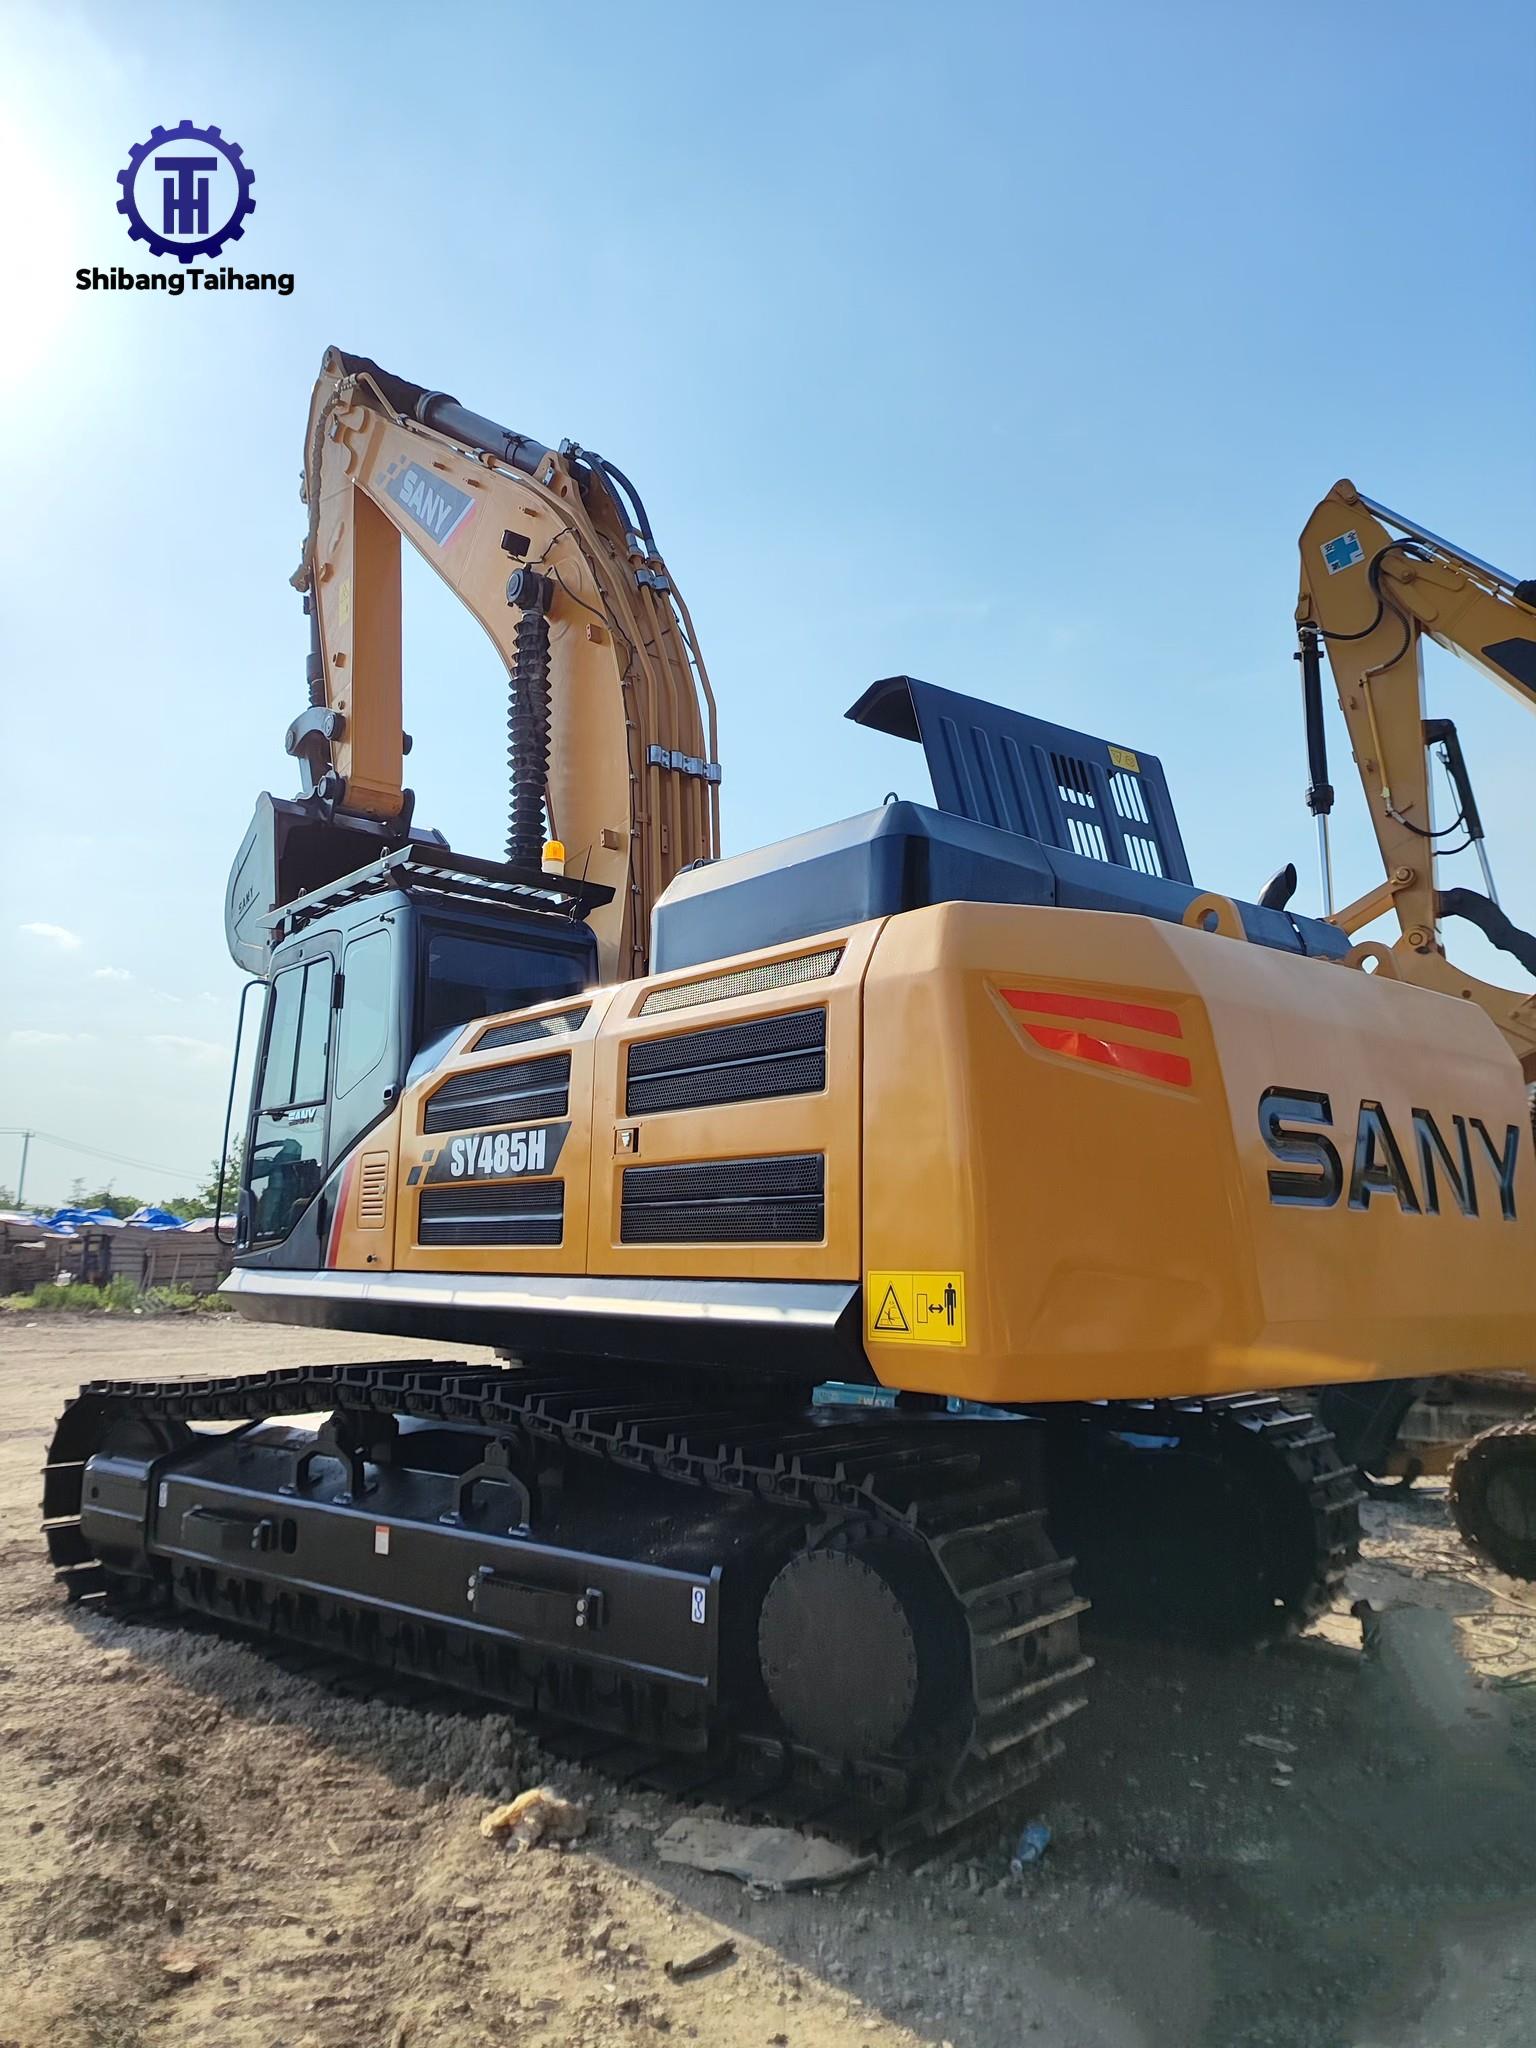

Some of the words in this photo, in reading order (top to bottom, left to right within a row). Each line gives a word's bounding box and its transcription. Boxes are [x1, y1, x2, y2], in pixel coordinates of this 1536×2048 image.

[399, 470, 453, 535] SANY
[450, 1129, 547, 1177] SY485H
[1258, 1085, 1520, 1222] SANY
